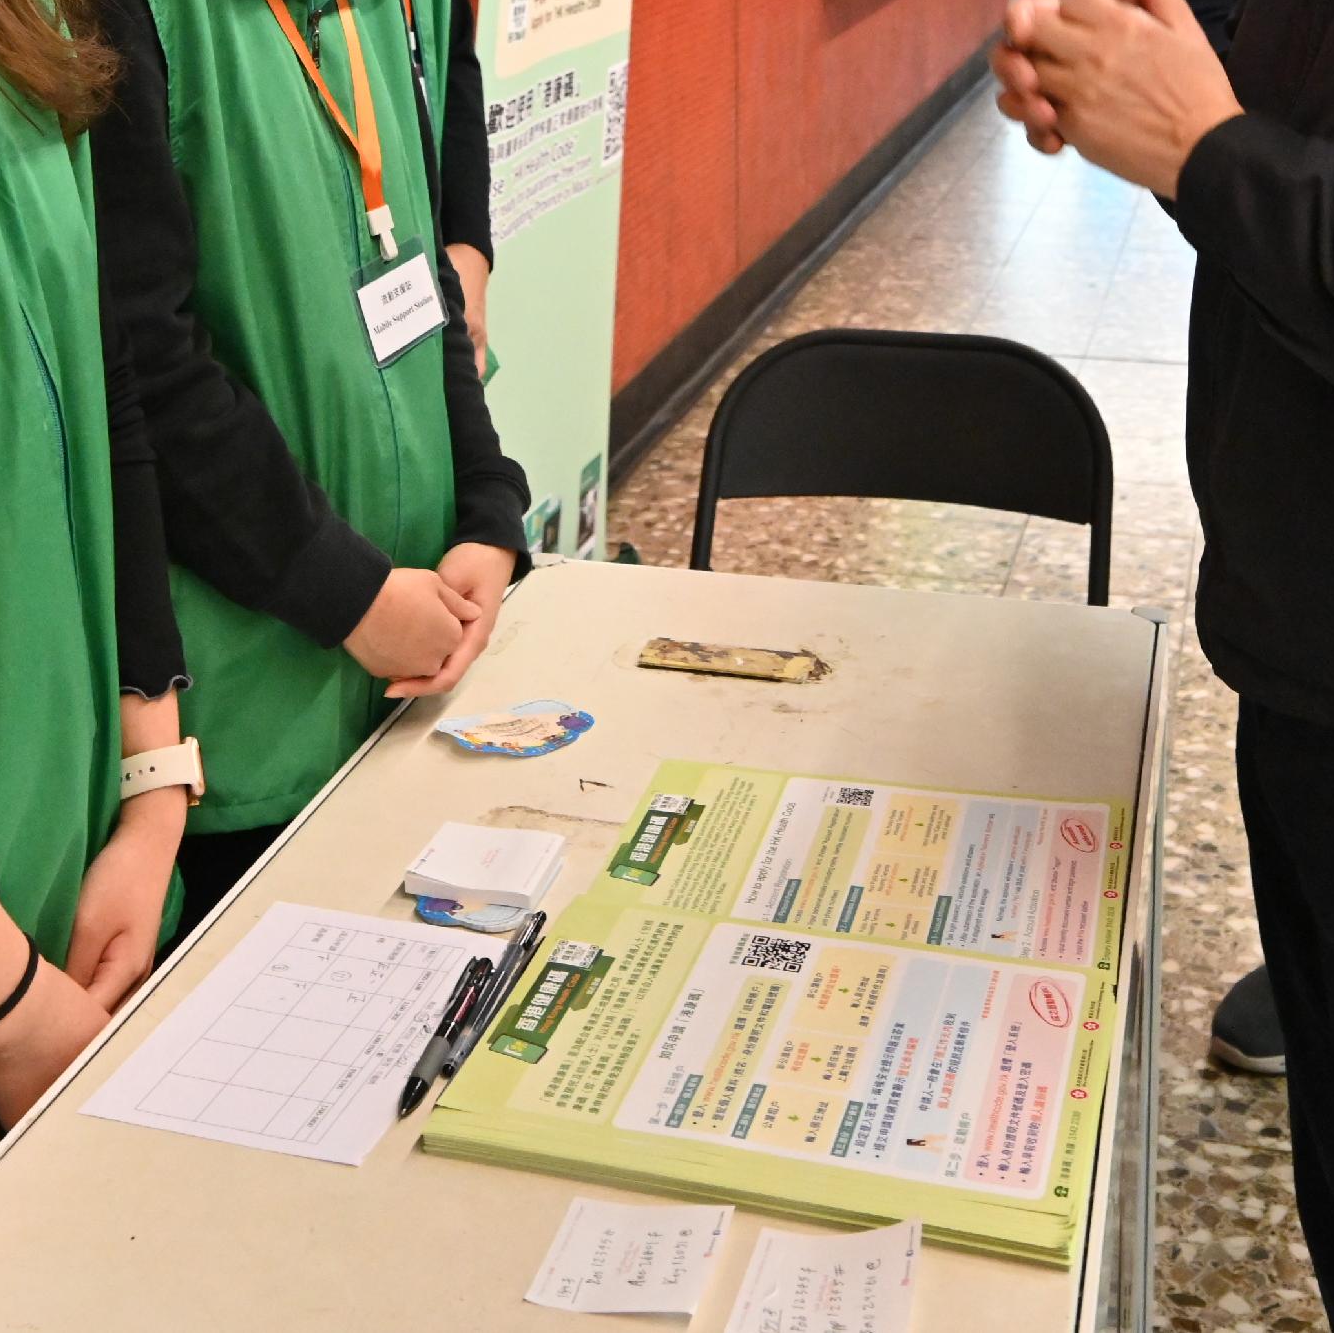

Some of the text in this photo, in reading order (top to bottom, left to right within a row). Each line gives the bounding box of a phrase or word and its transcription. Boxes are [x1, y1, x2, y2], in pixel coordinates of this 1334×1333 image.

[773, 817, 790, 835] Health
[765, 845, 778, 855] the
[761, 855, 774, 864] for
[754, 865, 771, 881] apply
[745, 889, 761, 904] How
[513, 969, 570, 1031] 香港健康碼
